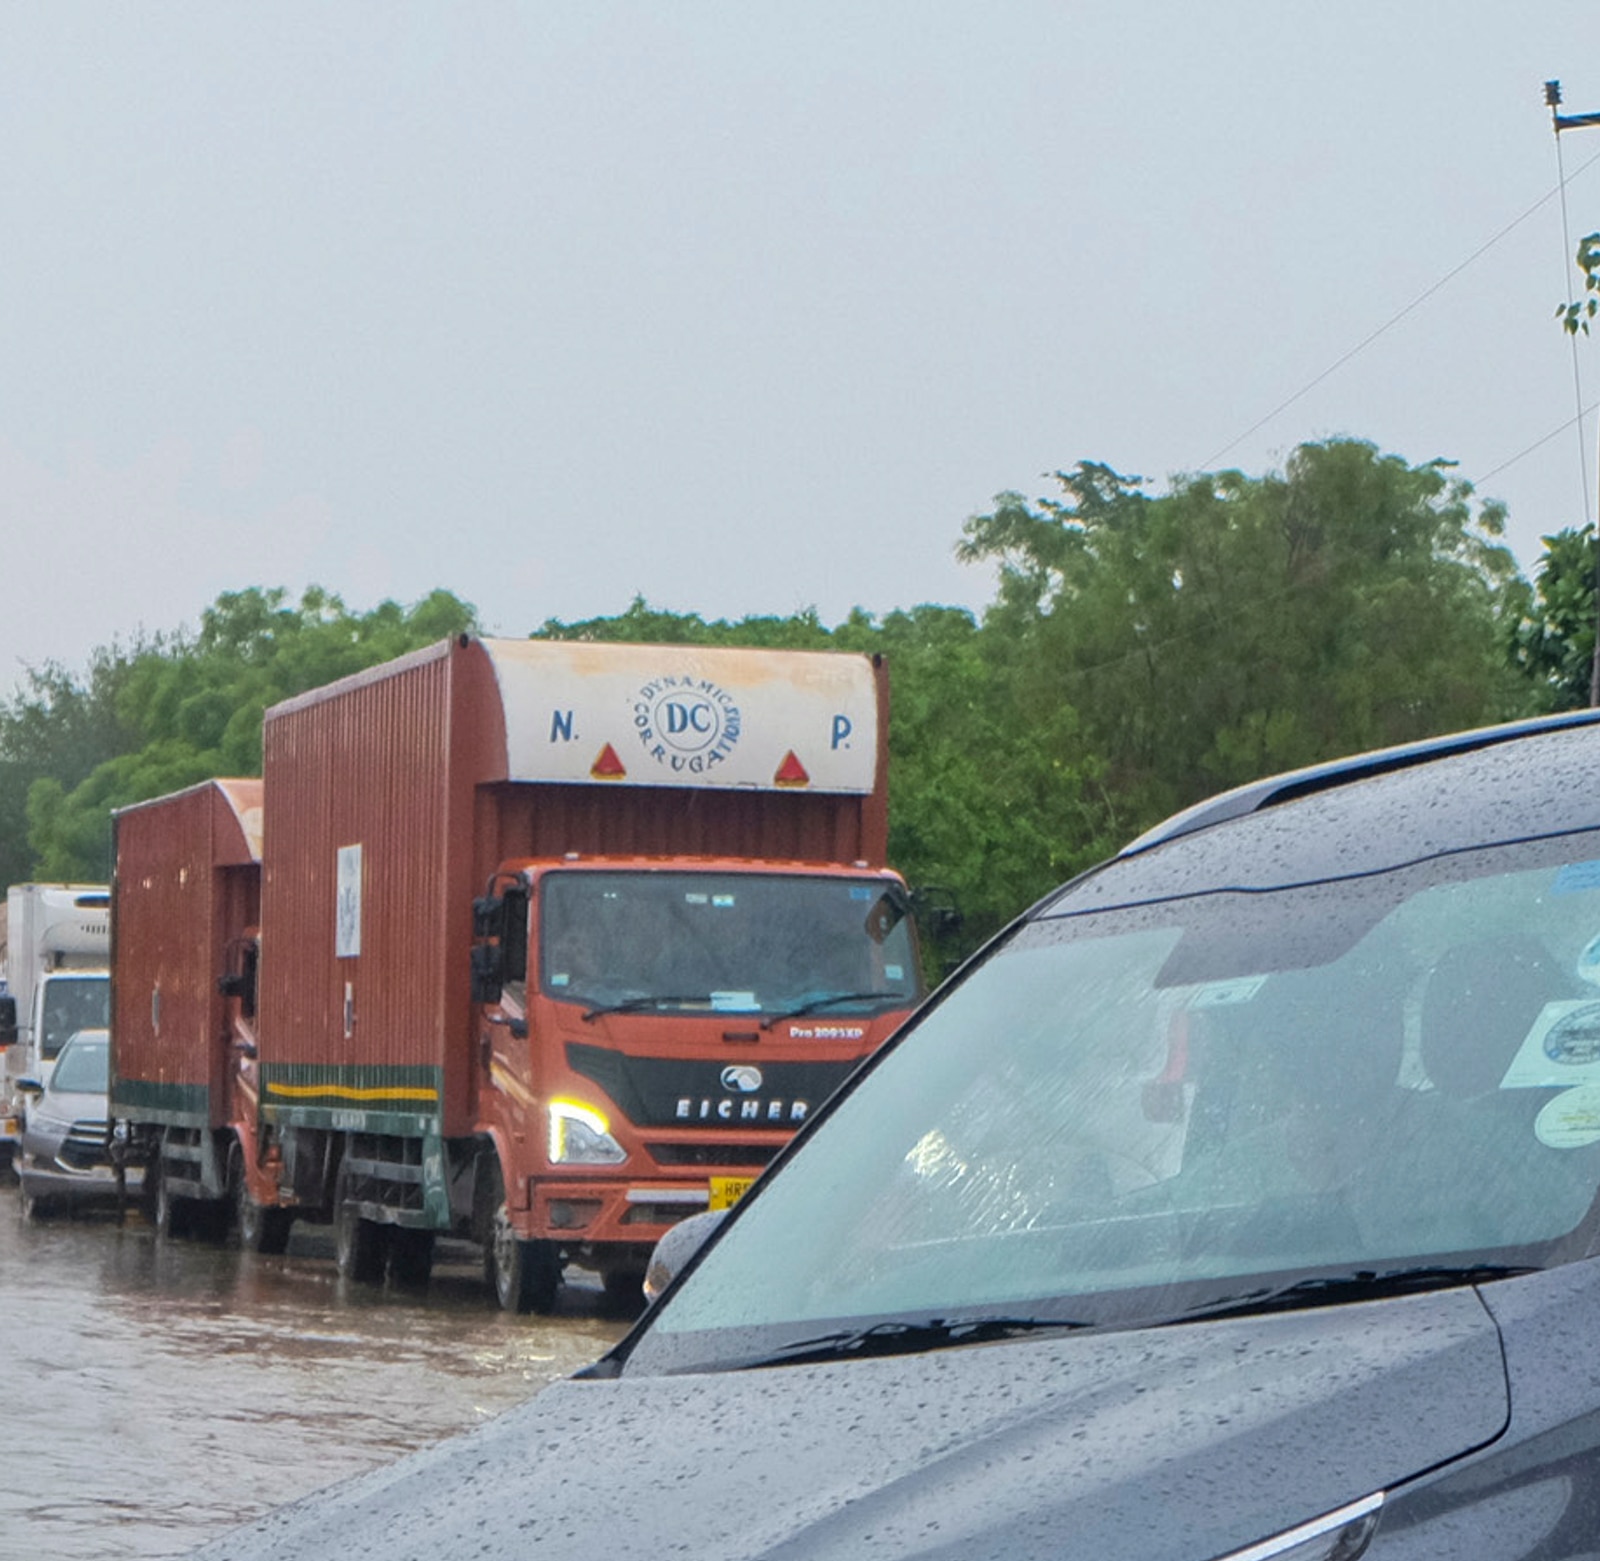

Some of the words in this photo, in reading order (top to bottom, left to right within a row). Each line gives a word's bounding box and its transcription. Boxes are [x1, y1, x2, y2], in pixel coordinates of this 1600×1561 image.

[550, 710, 580, 743] N.
[666, 702, 711, 733] DC
[831, 715, 852, 750] P.
[789, 1026, 813, 1039] Pro
[676, 1098, 808, 1120] EICHER
